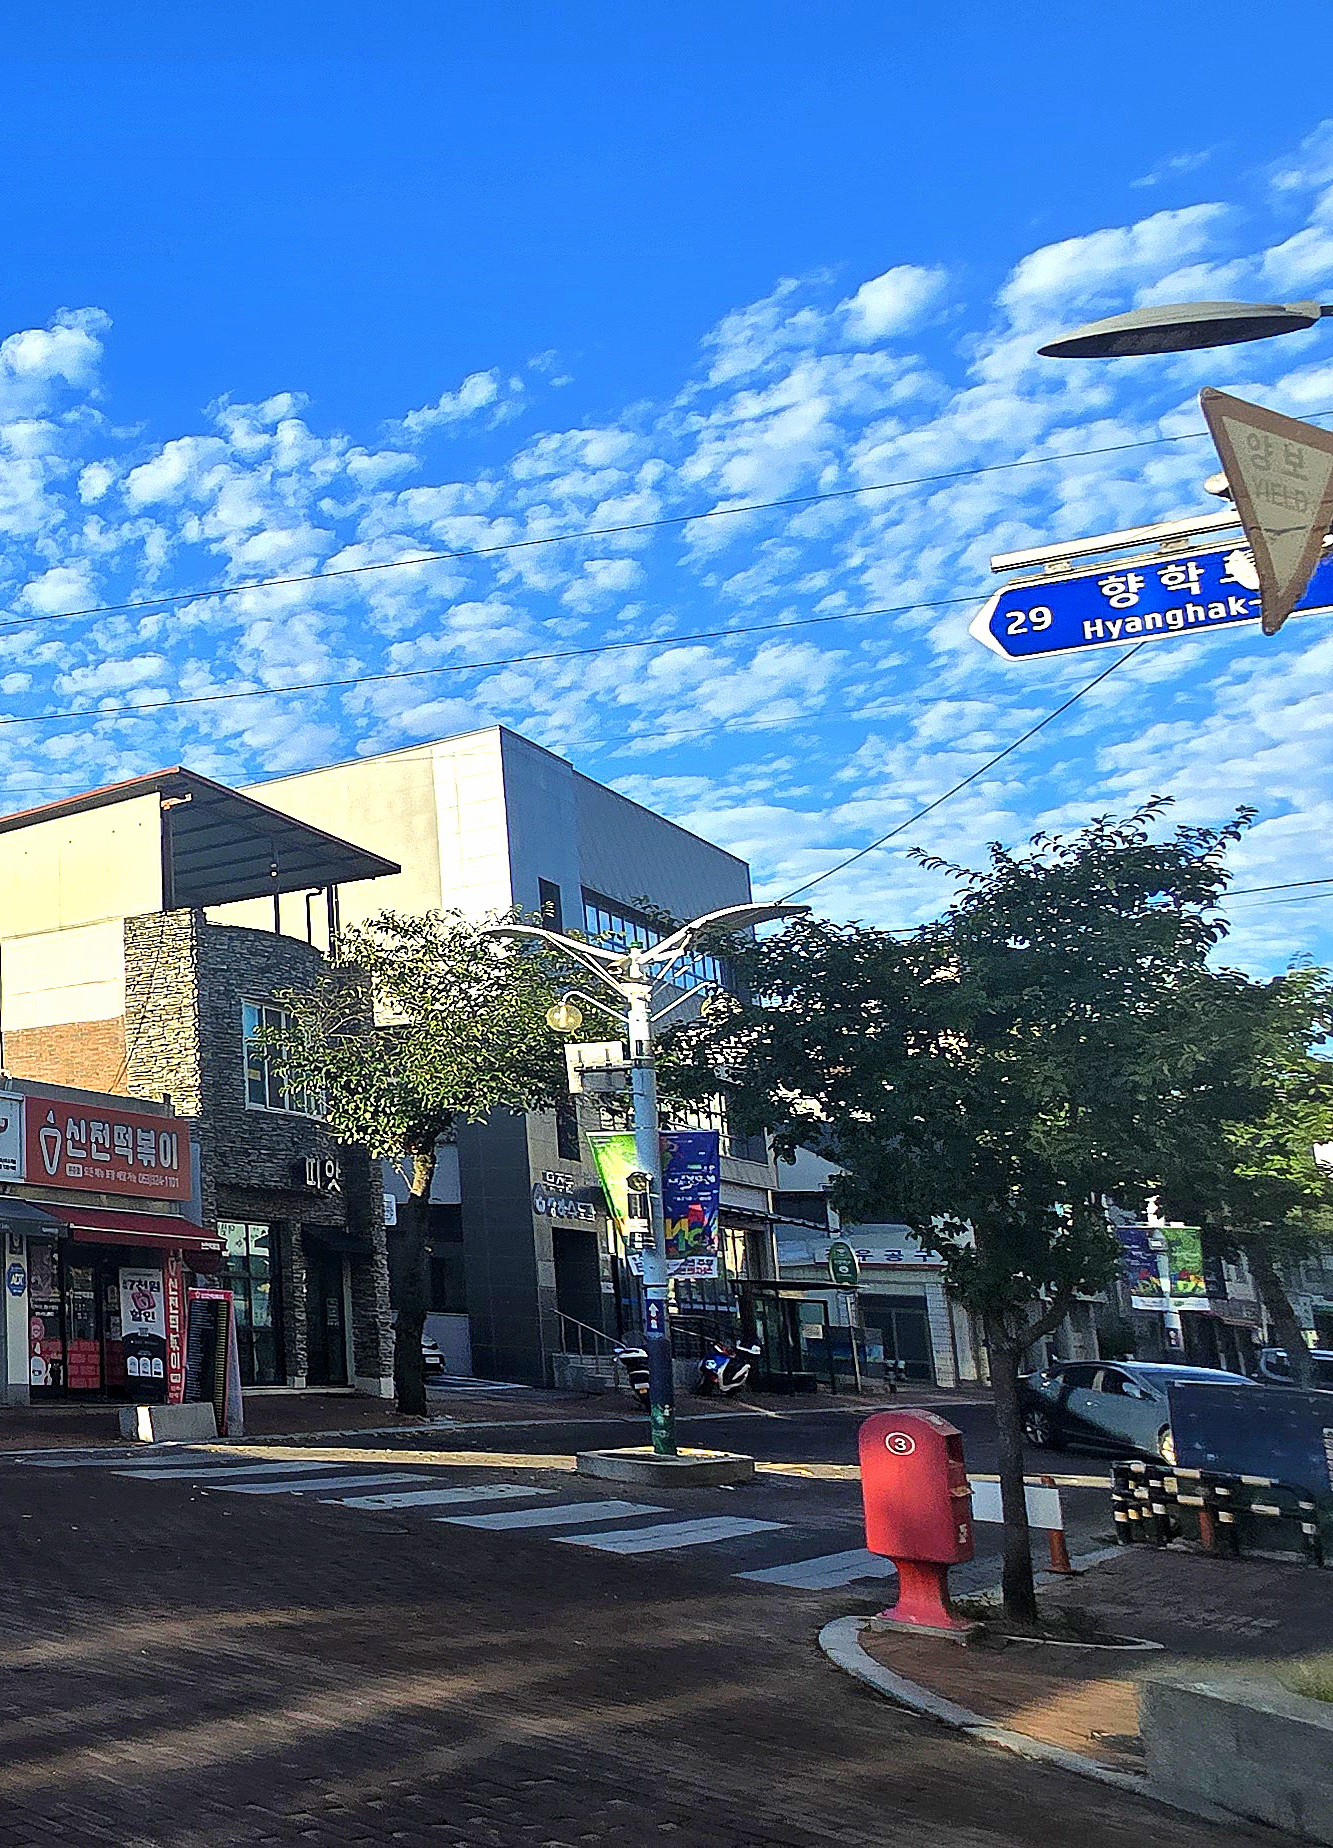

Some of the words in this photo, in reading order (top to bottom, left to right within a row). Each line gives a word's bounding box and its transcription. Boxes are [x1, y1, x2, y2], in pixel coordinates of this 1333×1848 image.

[1005, 606, 1053, 636] 29
[1082, 596, 1262, 641] Hyanghak-
[65, 1117, 179, 1170] 신전떡볶이
[824, 1248, 935, 1263] 우공구
